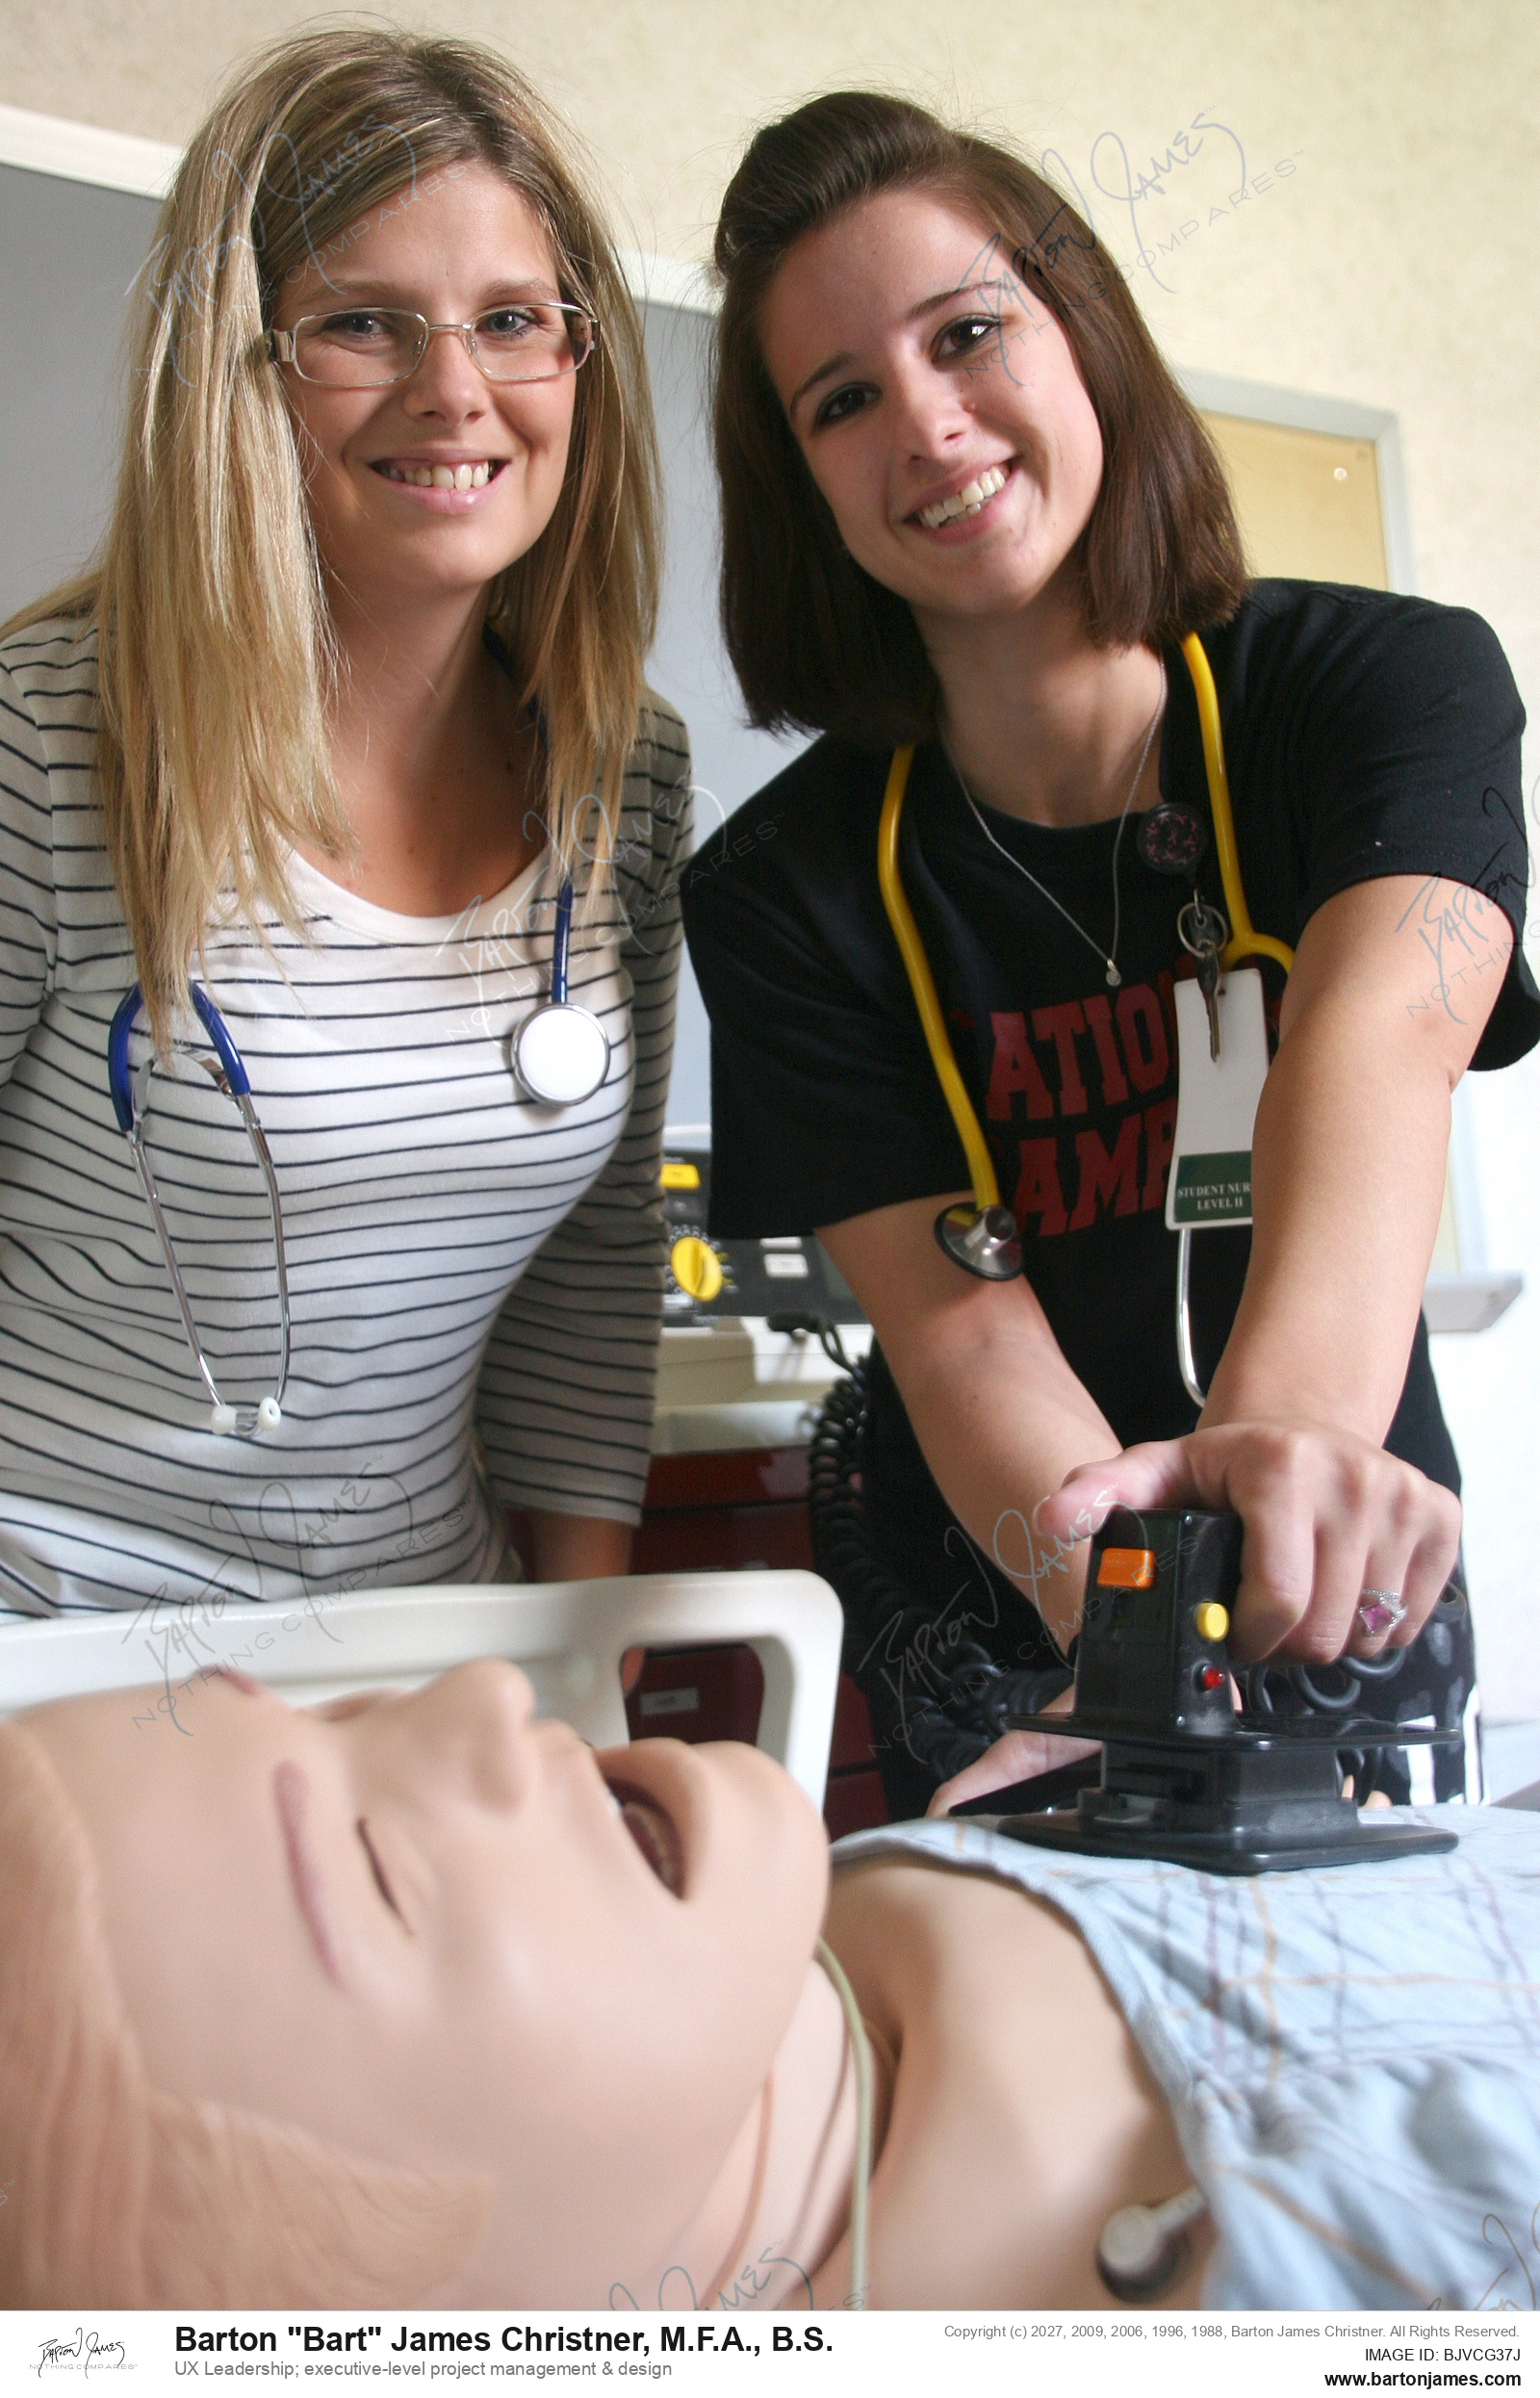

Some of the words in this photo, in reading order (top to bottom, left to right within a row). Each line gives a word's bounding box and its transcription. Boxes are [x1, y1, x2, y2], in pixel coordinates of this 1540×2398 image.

[1176, 1184, 1226, 1199] STUDENT
[1227, 1180, 1251, 1195] NUR
[1196, 1197, 1233, 1211] LEVEL
